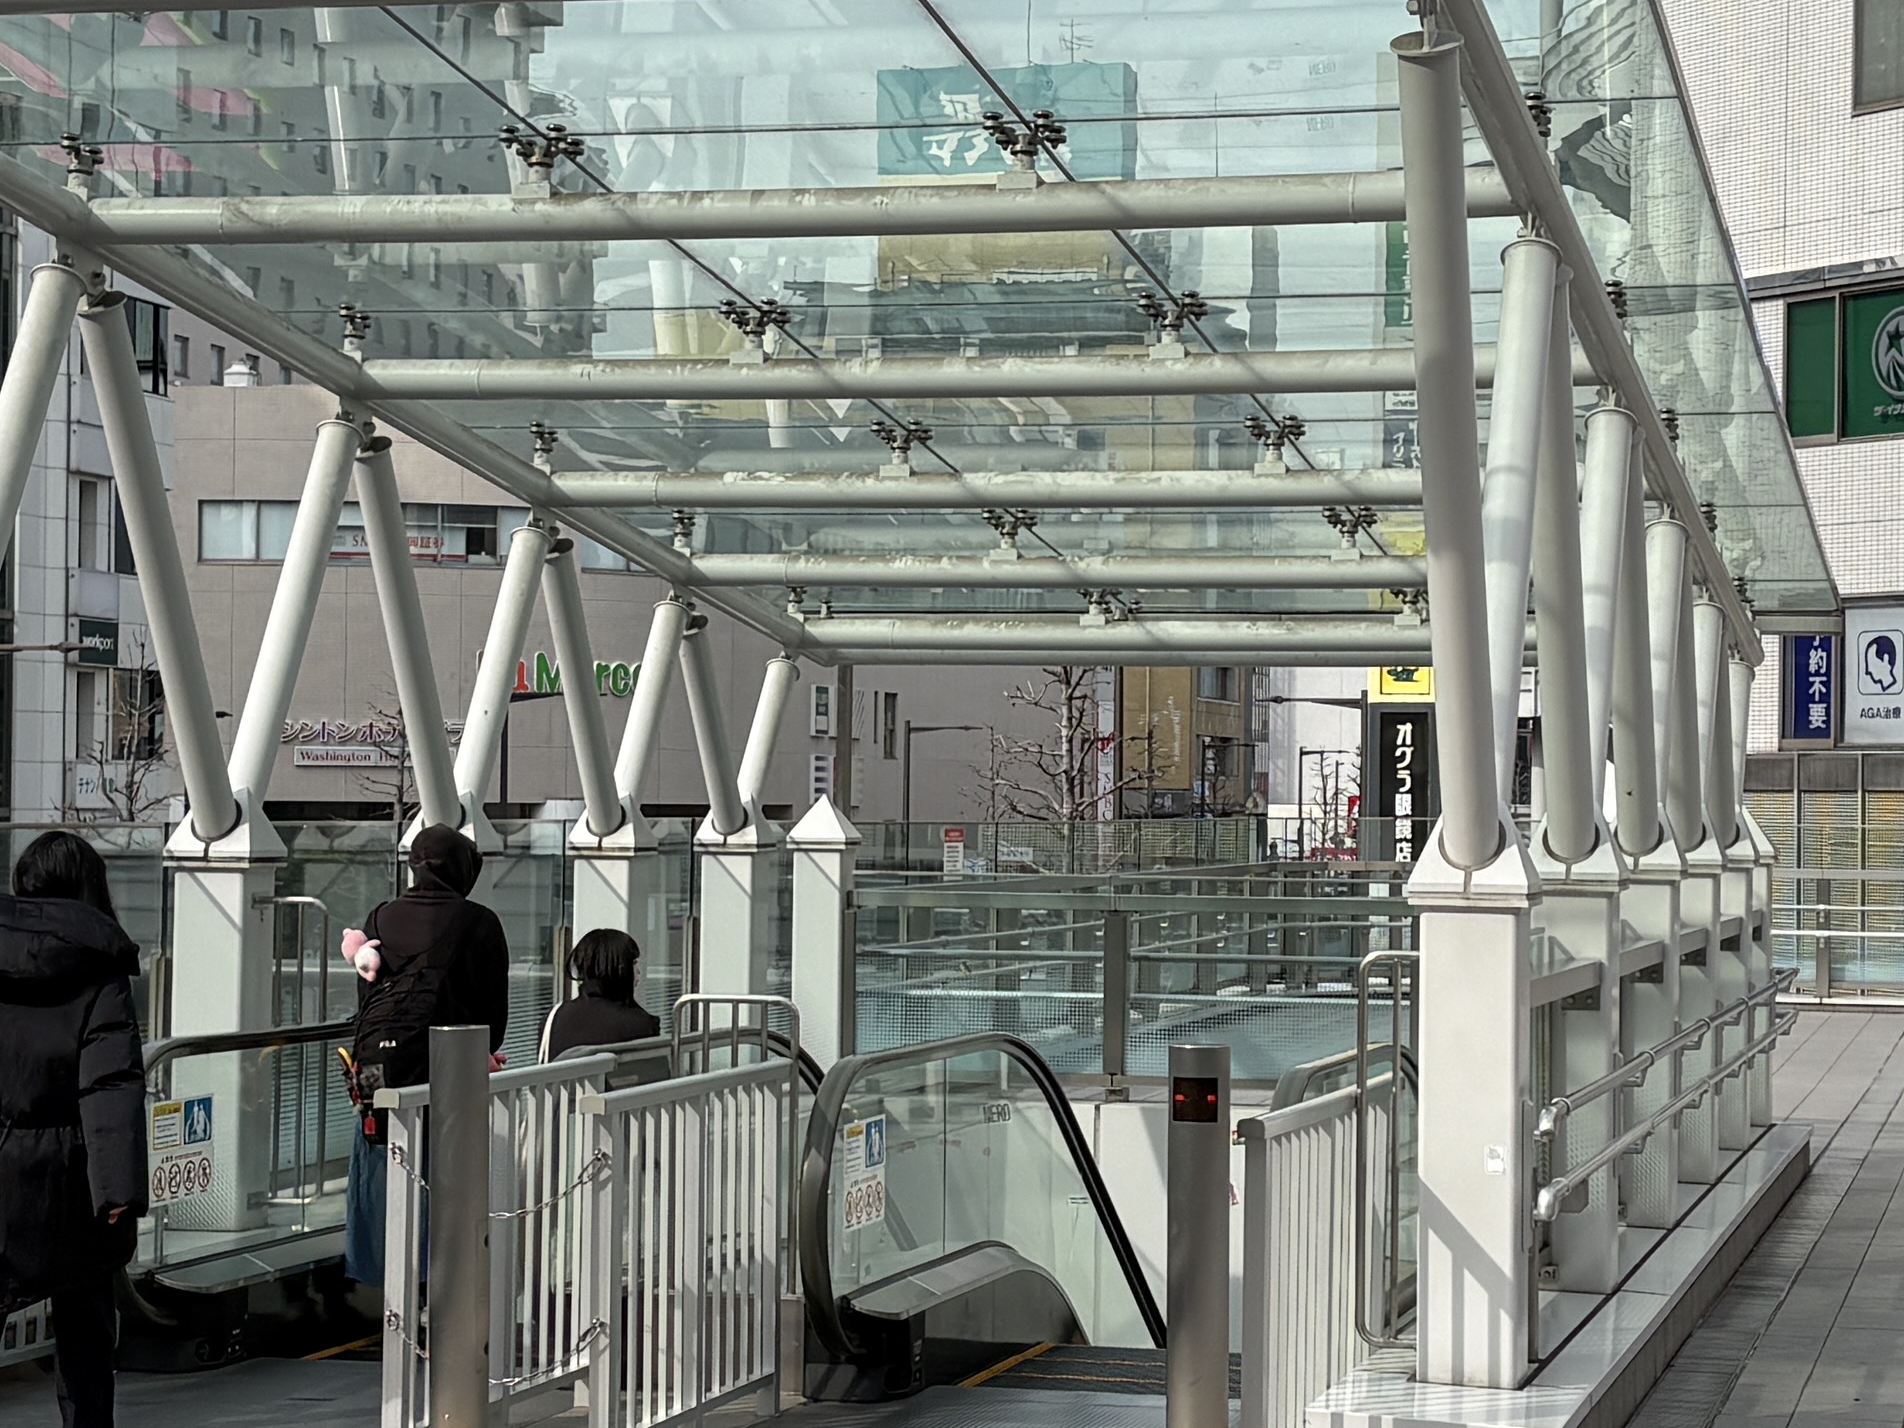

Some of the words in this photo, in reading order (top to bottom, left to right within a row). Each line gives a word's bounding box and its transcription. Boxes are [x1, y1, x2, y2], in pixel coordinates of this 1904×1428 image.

[300, 750, 372, 764] Washington
[1395, 722, 1415, 863] オグラ眼鏡店
